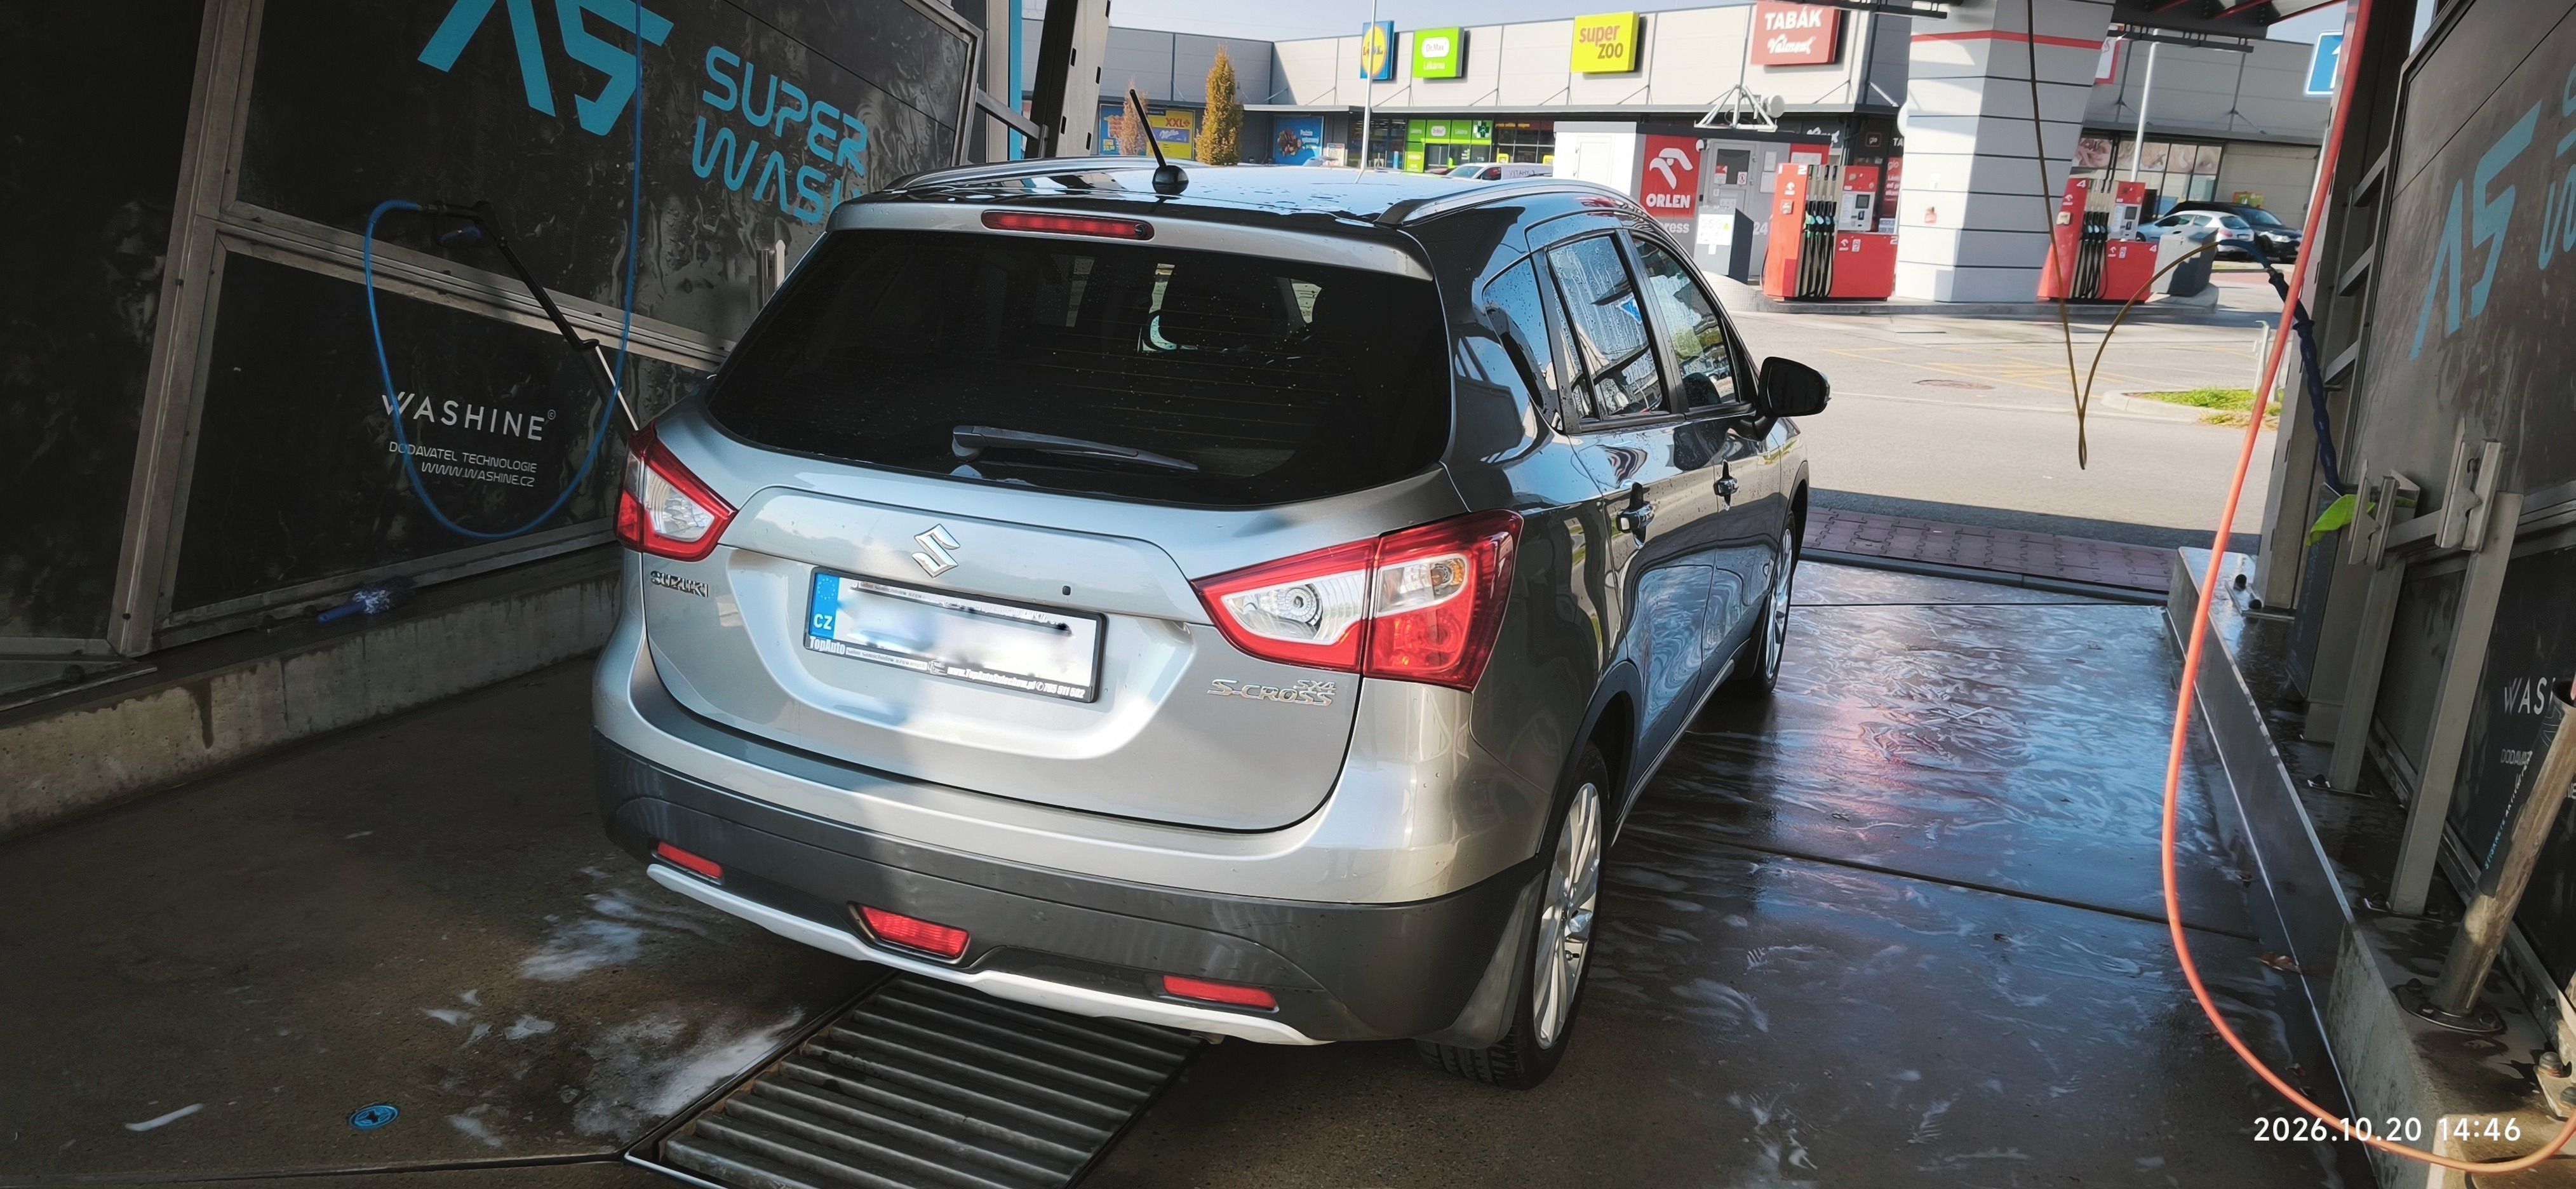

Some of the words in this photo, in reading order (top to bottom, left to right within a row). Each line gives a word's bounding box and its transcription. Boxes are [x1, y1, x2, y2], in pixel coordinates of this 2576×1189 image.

[1765, 6, 1824, 30] TABÁK
[1579, 25, 1621, 47] super
[1597, 43, 1624, 59] zoo
[702, 46, 868, 177] SUPER
[1165, 118, 1185, 127] XXL
[1893, 137, 1903, 147] TA
[1797, 165, 1808, 175] 2
[2076, 180, 2086, 188] 4
[1646, 193, 1691, 208] ORLEN
[1889, 236, 1898, 245] 2
[389, 441, 457, 462] DODAVATEL
[462, 452, 537, 473] TECHNOLOGIE
[650, 570, 709, 598] SUZUKI
[813, 613, 833, 631] CZ
[809, 636, 846, 655] TopAuto
[1207, 678, 1336, 707] S-CROSS
[1293, 679, 1337, 694] SX4
